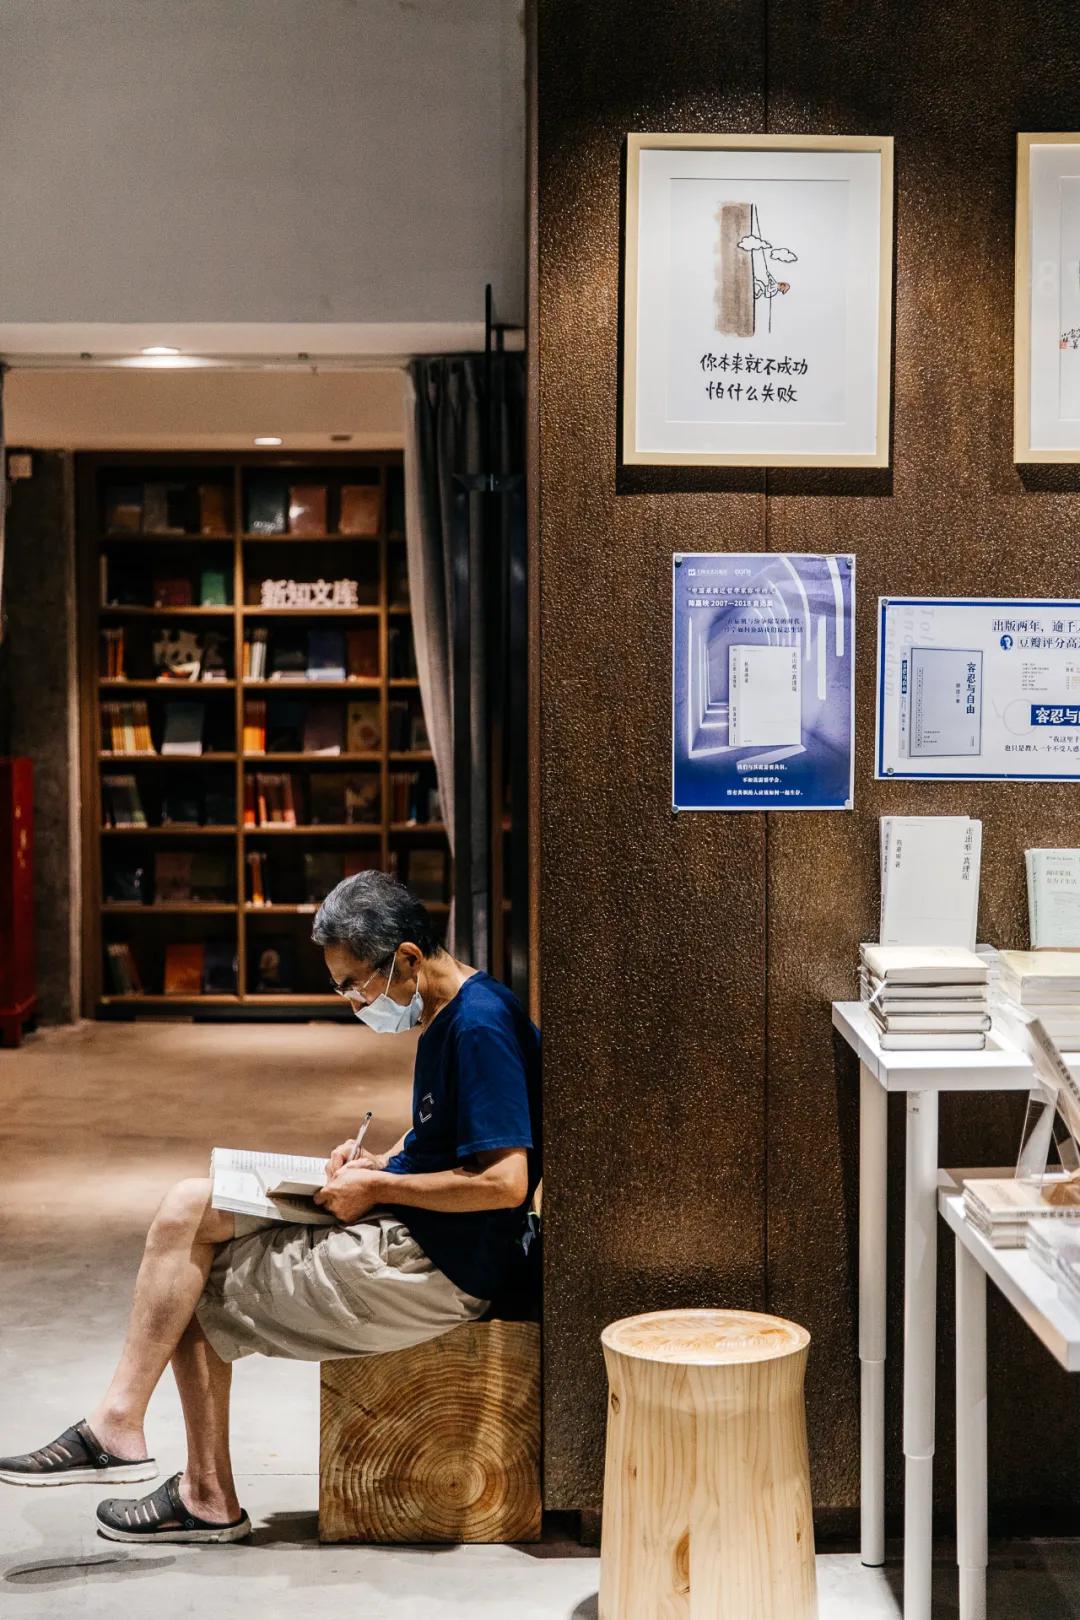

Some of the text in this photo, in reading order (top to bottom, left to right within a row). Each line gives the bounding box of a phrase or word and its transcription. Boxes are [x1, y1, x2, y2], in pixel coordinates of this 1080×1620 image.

[700, 352, 808, 376] 你本来就不成功
[705, 381, 798, 404] 怕什么失败
[260, 579, 359, 609] 新知文库
[1020, 637, 1080, 649] 豆瓣评分高
[966, 661, 976, 714] 容忍与自由
[1035, 707, 1080, 724] 容忍与
